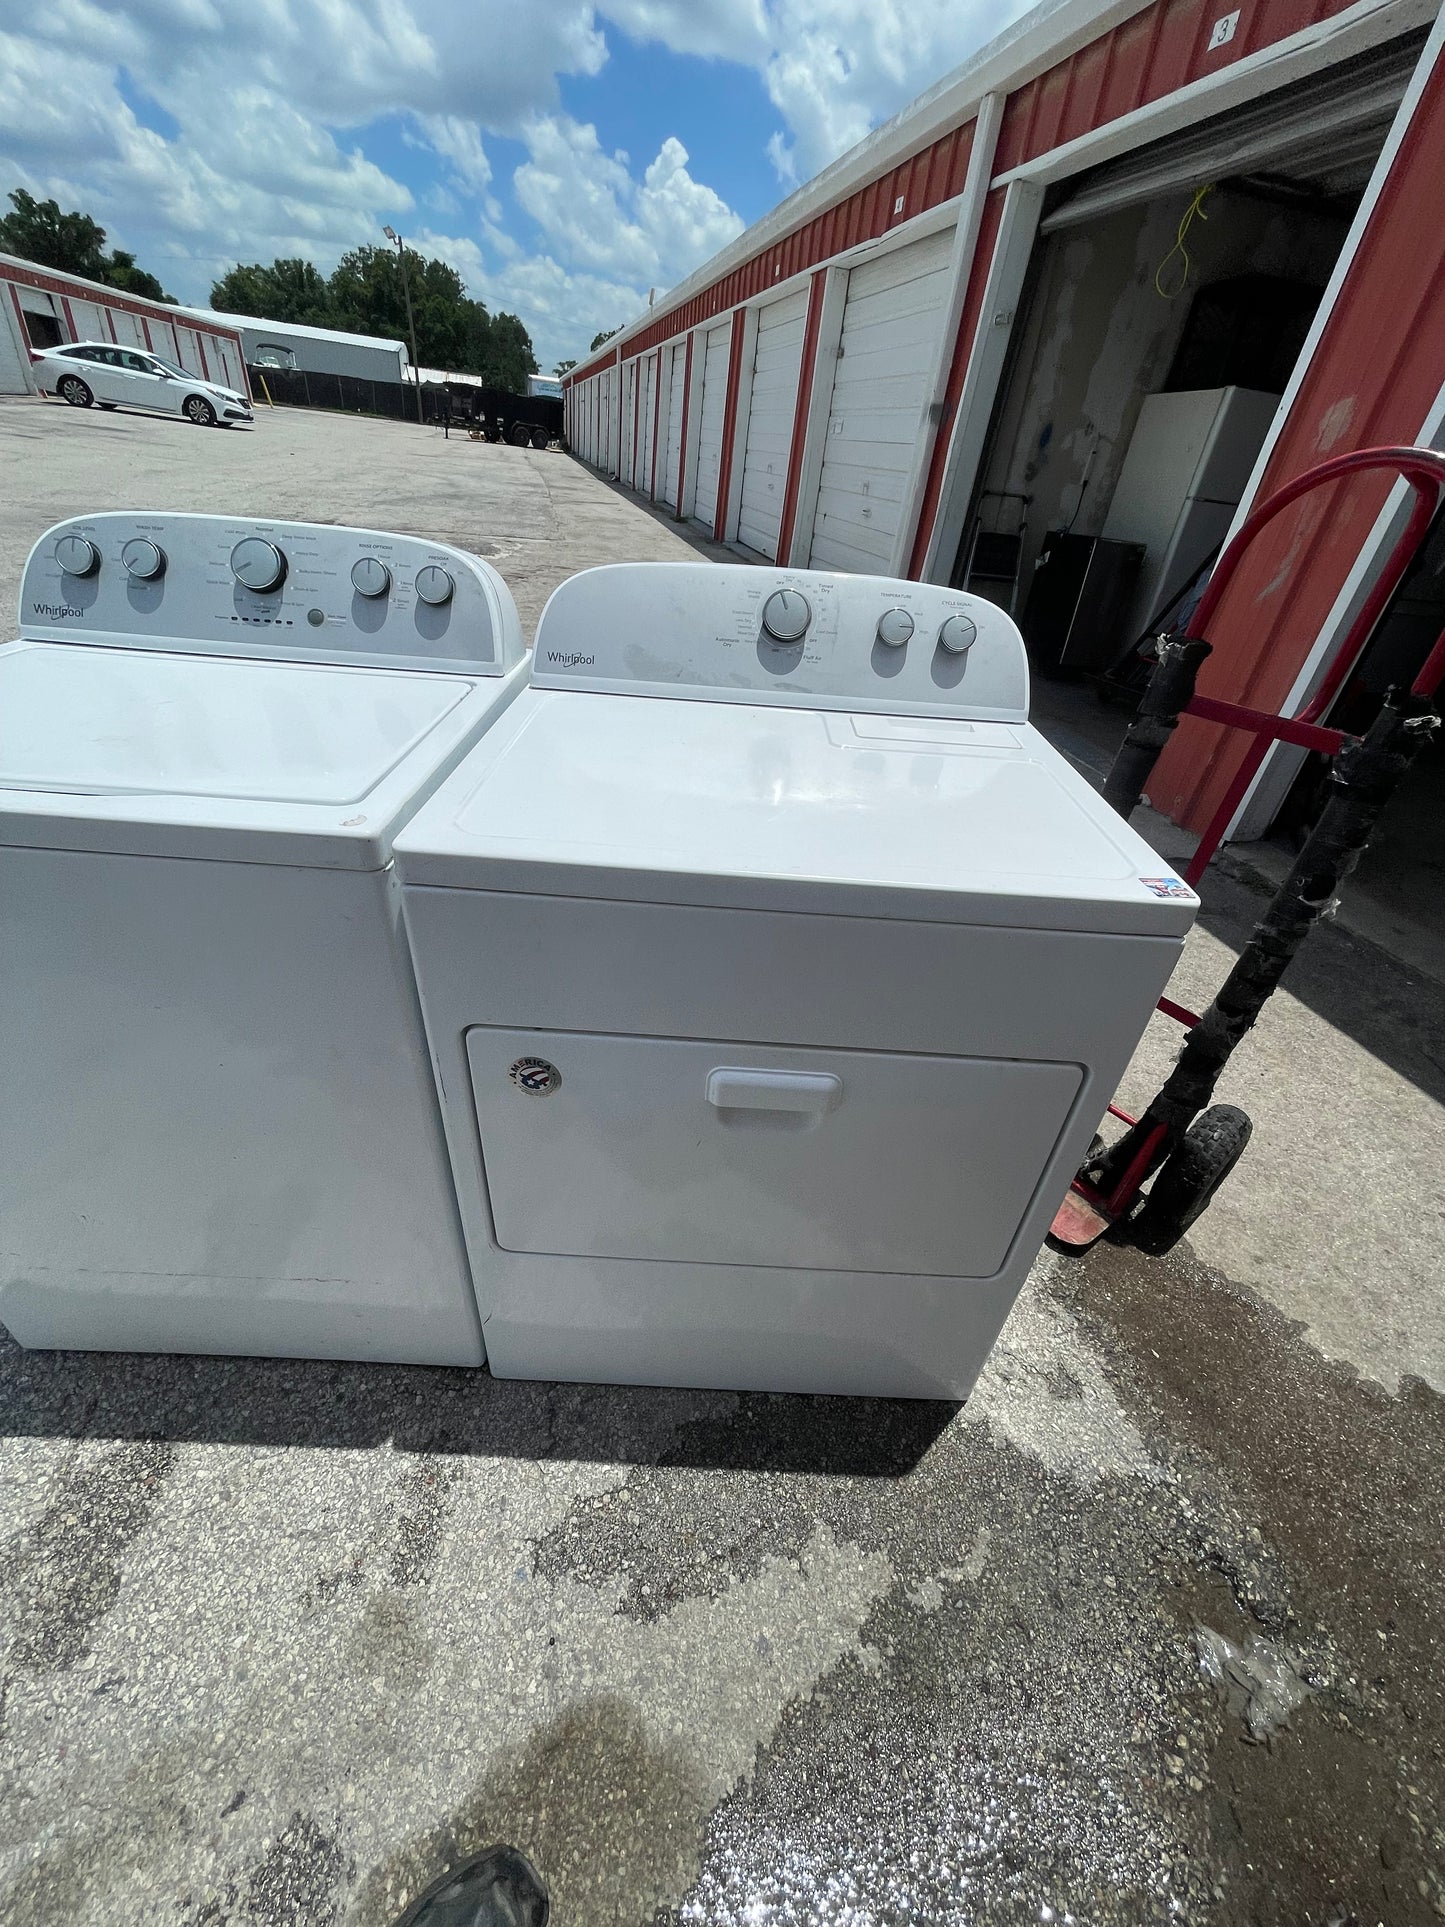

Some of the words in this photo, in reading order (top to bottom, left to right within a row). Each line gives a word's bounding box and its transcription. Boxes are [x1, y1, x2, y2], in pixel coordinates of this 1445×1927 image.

[1217, 19, 1229, 42] 3
[33, 603, 84, 620] Whirlpool
[547, 651, 595, 668] Whirlpool
